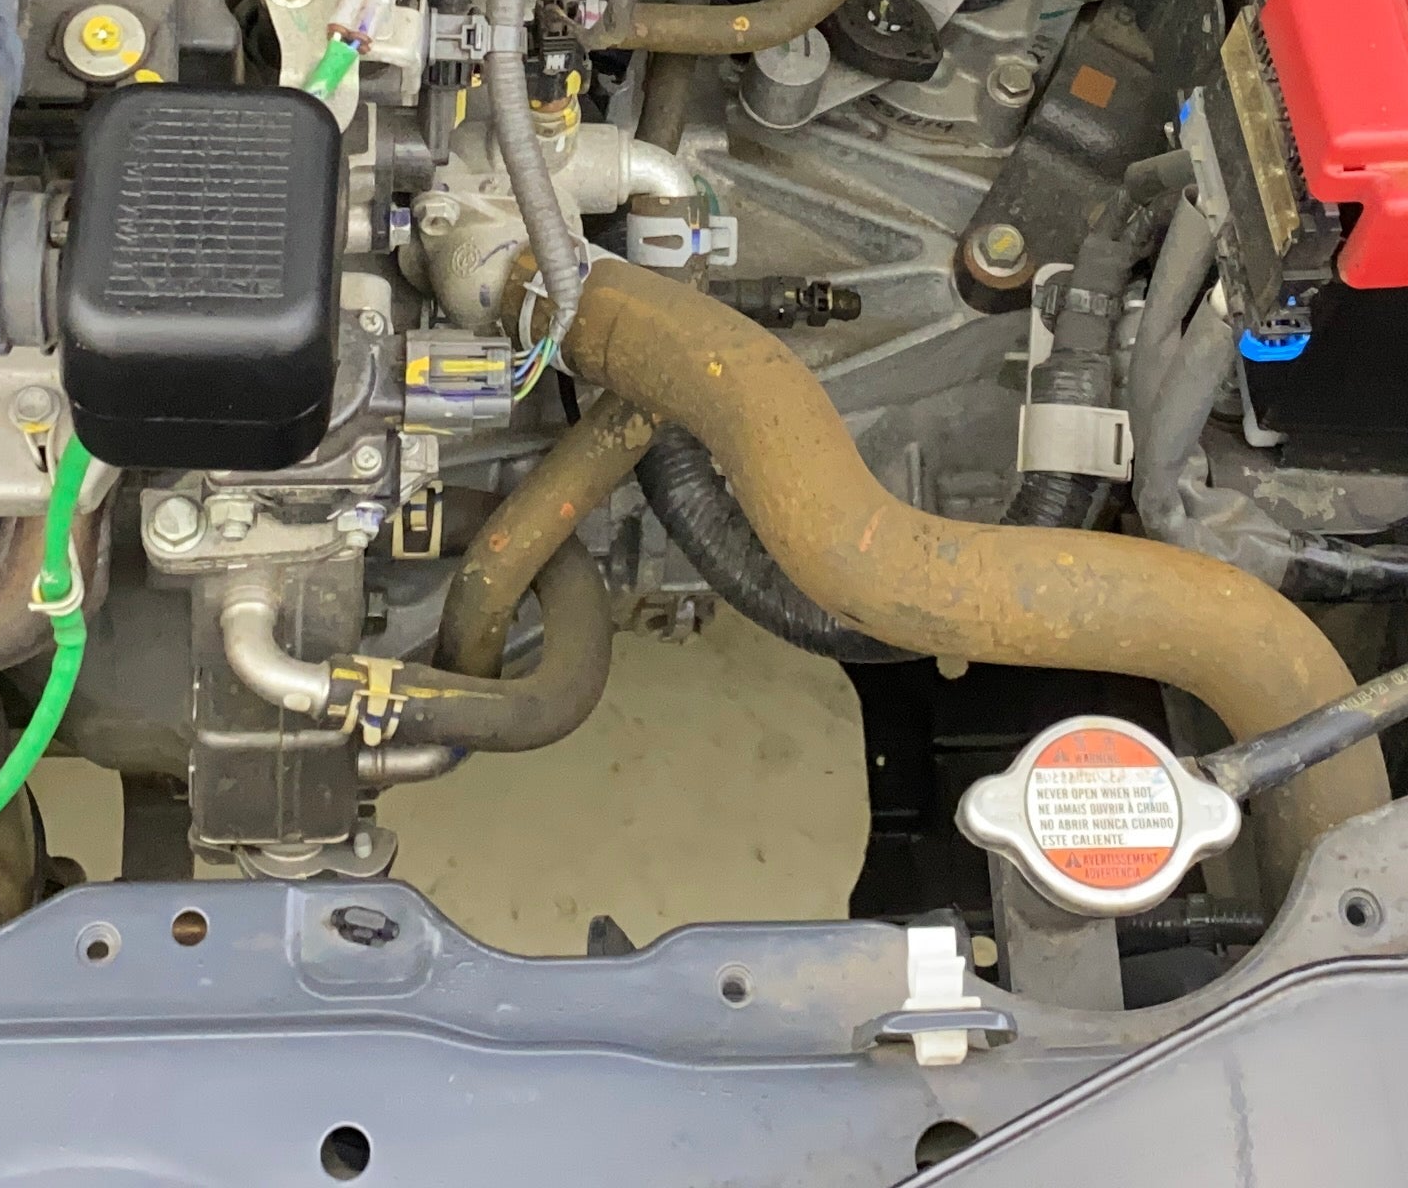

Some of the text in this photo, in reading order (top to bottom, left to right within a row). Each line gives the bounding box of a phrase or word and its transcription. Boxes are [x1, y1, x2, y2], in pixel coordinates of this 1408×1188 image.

[1076, 752, 1121, 764] WARNING
[1037, 788, 1069, 800] NEVER
[1072, 787, 1098, 800] OPEN
[1101, 786, 1130, 799] WHEN
[1038, 803, 1051, 816] NE
[1054, 803, 1087, 815] JAMAIS
[1090, 802, 1125, 815] OUVRIR
[1040, 817, 1175, 831] NO ABRIR NUNCA CUANDO
[1042, 834, 1068, 846] ESTE
[1083, 853, 1159, 866] AVERTISSEMENT
[1085, 867, 1142, 879] ADVERTENCIA
